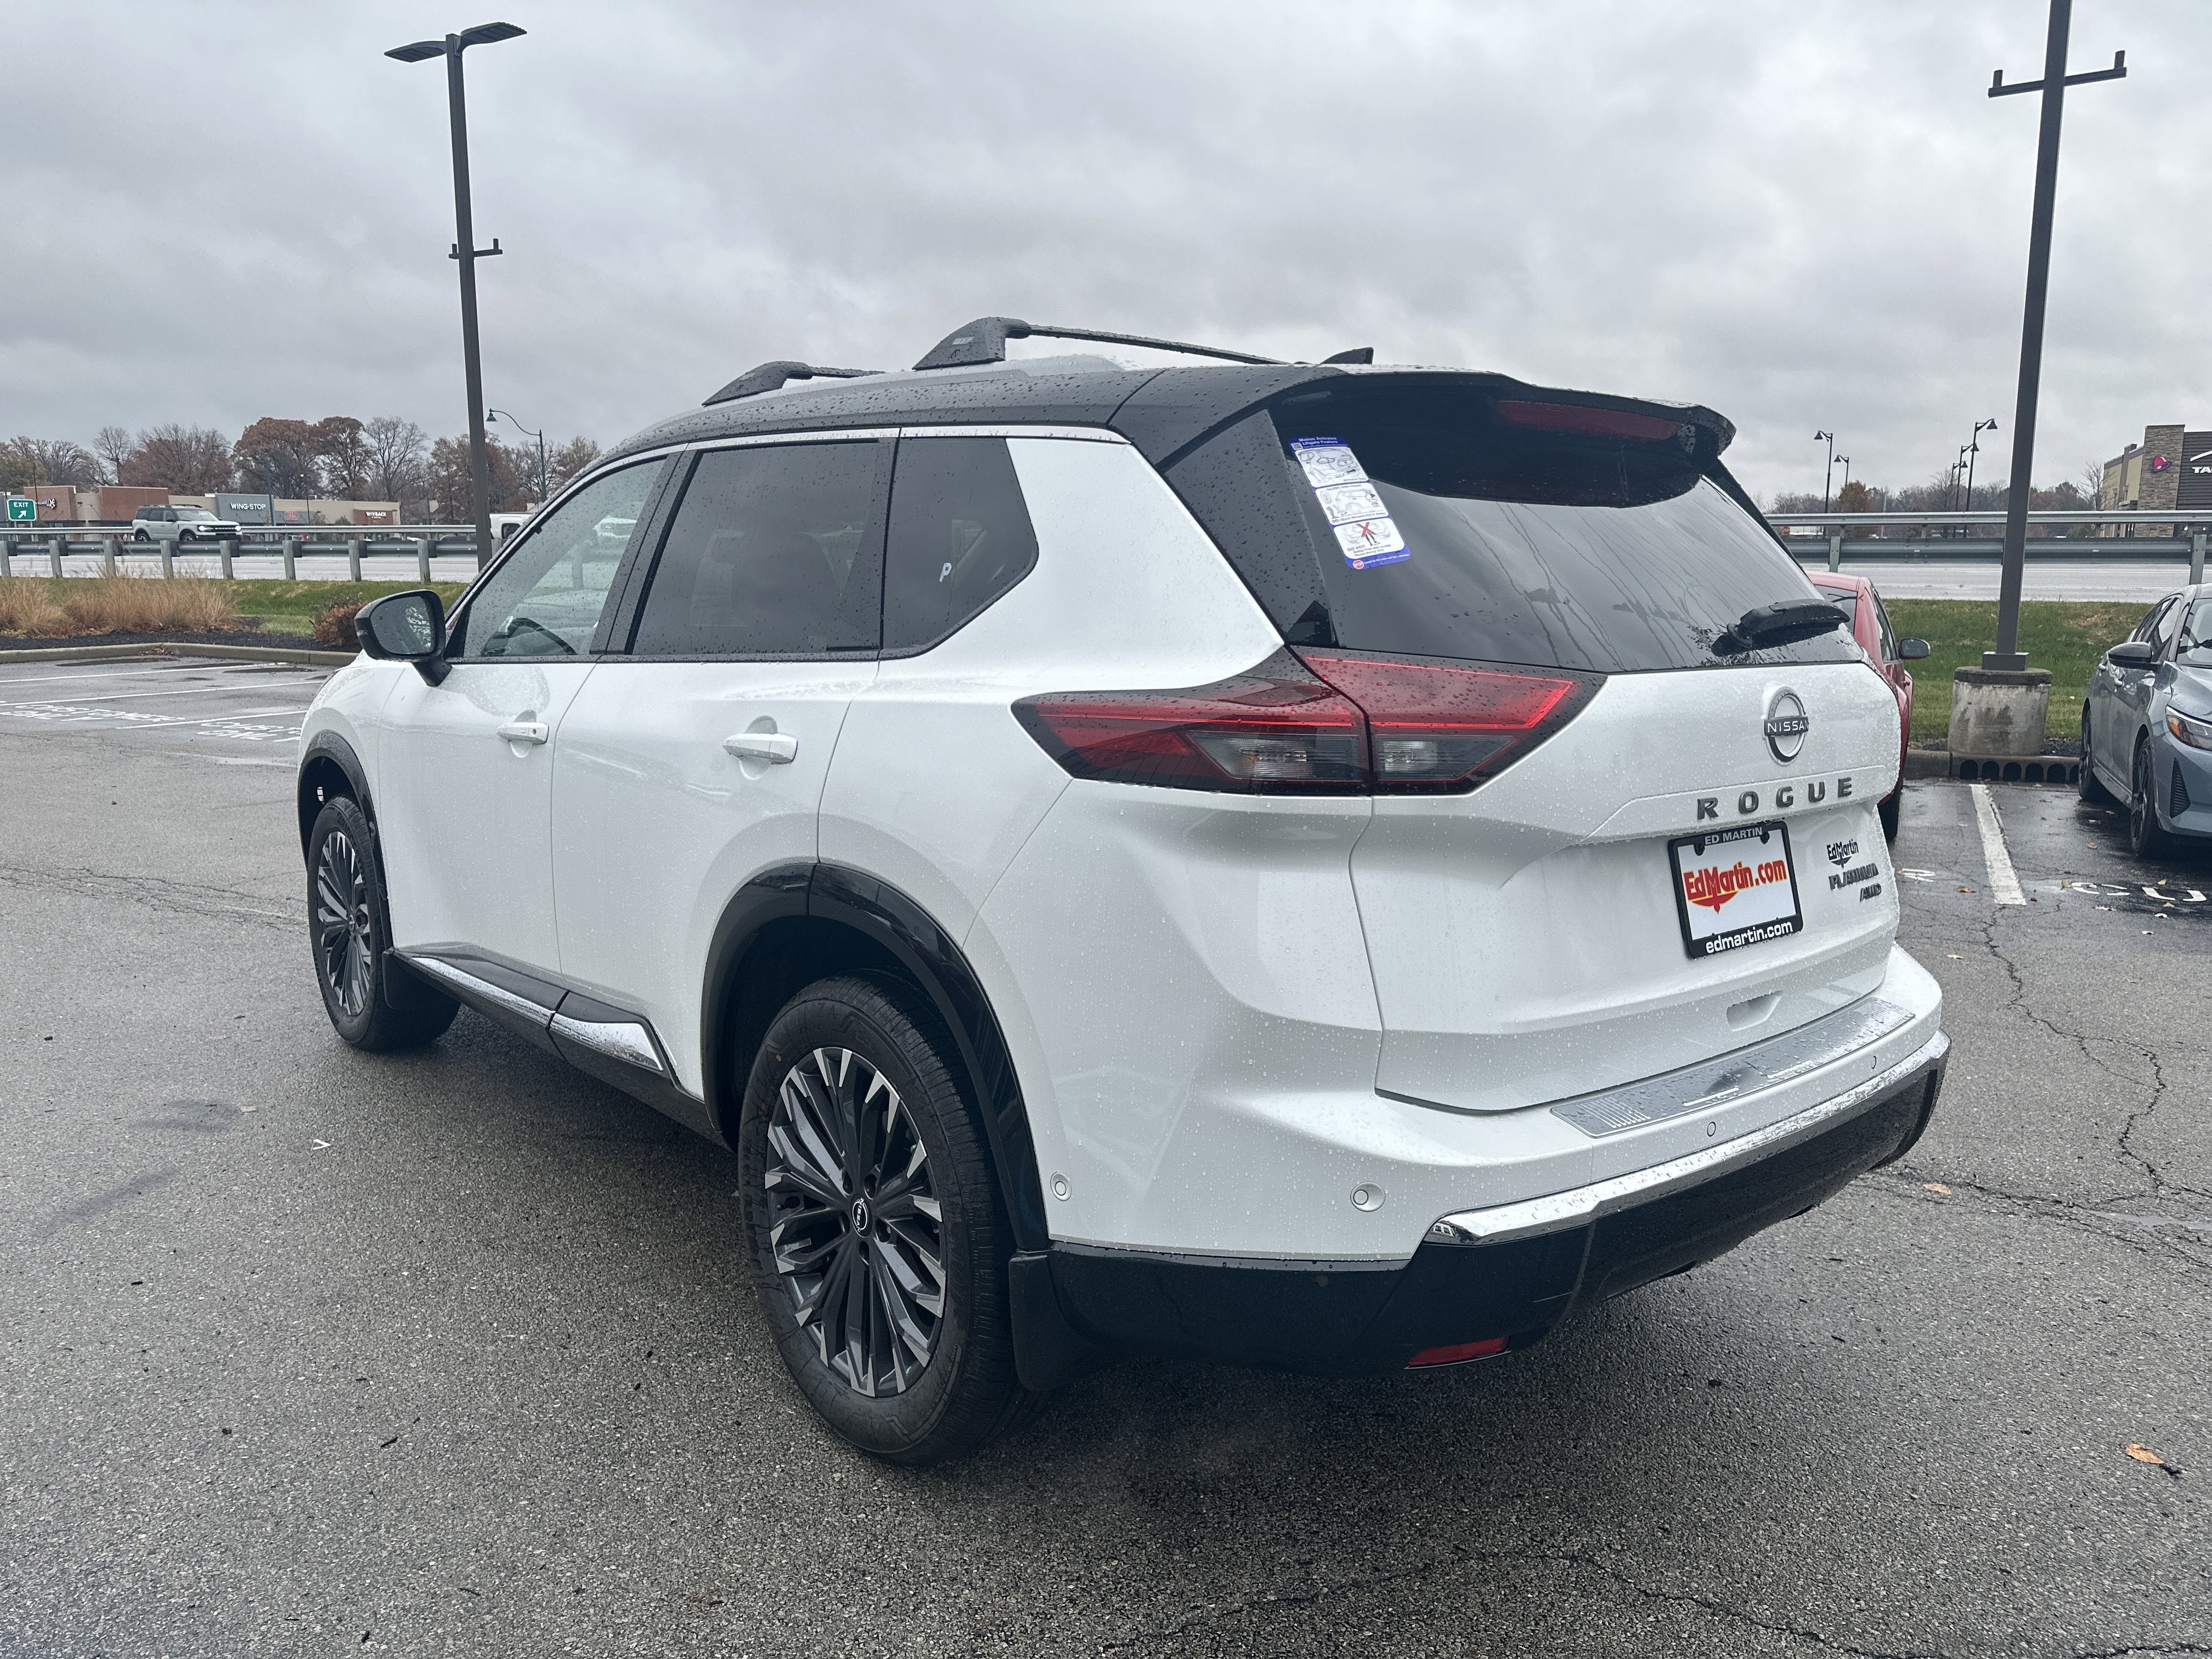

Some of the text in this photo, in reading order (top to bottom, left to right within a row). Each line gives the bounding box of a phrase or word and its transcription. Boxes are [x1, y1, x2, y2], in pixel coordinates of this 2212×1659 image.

[1767, 720, 1809, 733] NISSAN
[1696, 776, 1853, 821] ROGUE
[1705, 827, 1763, 846] ED MARTIN
[1826, 838, 1859, 861] EdMartin
[1683, 859, 1787, 902] EdMartin.com
[1706, 920, 1793, 954] edmartin.com
